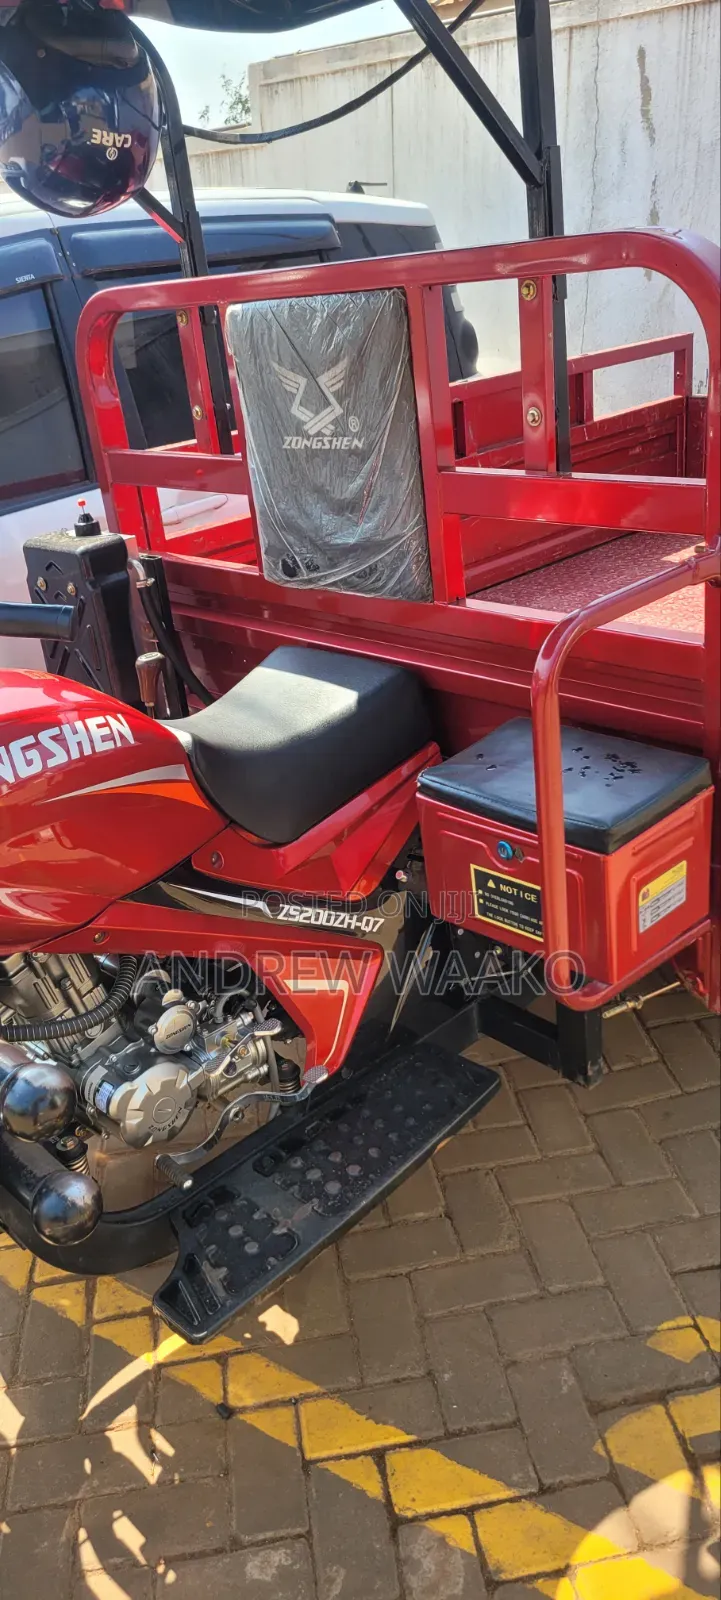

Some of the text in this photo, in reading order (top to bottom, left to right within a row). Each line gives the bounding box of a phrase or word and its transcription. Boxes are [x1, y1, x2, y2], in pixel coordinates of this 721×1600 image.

[90, 128, 132, 148] CARE
[282, 436, 365, 450] ZONGSHEN
[0, 713, 135, 784] NGSHEN
[499, 883, 537, 902] NOTICE
[276, 903, 385, 933] ZS200ZH-Q7
